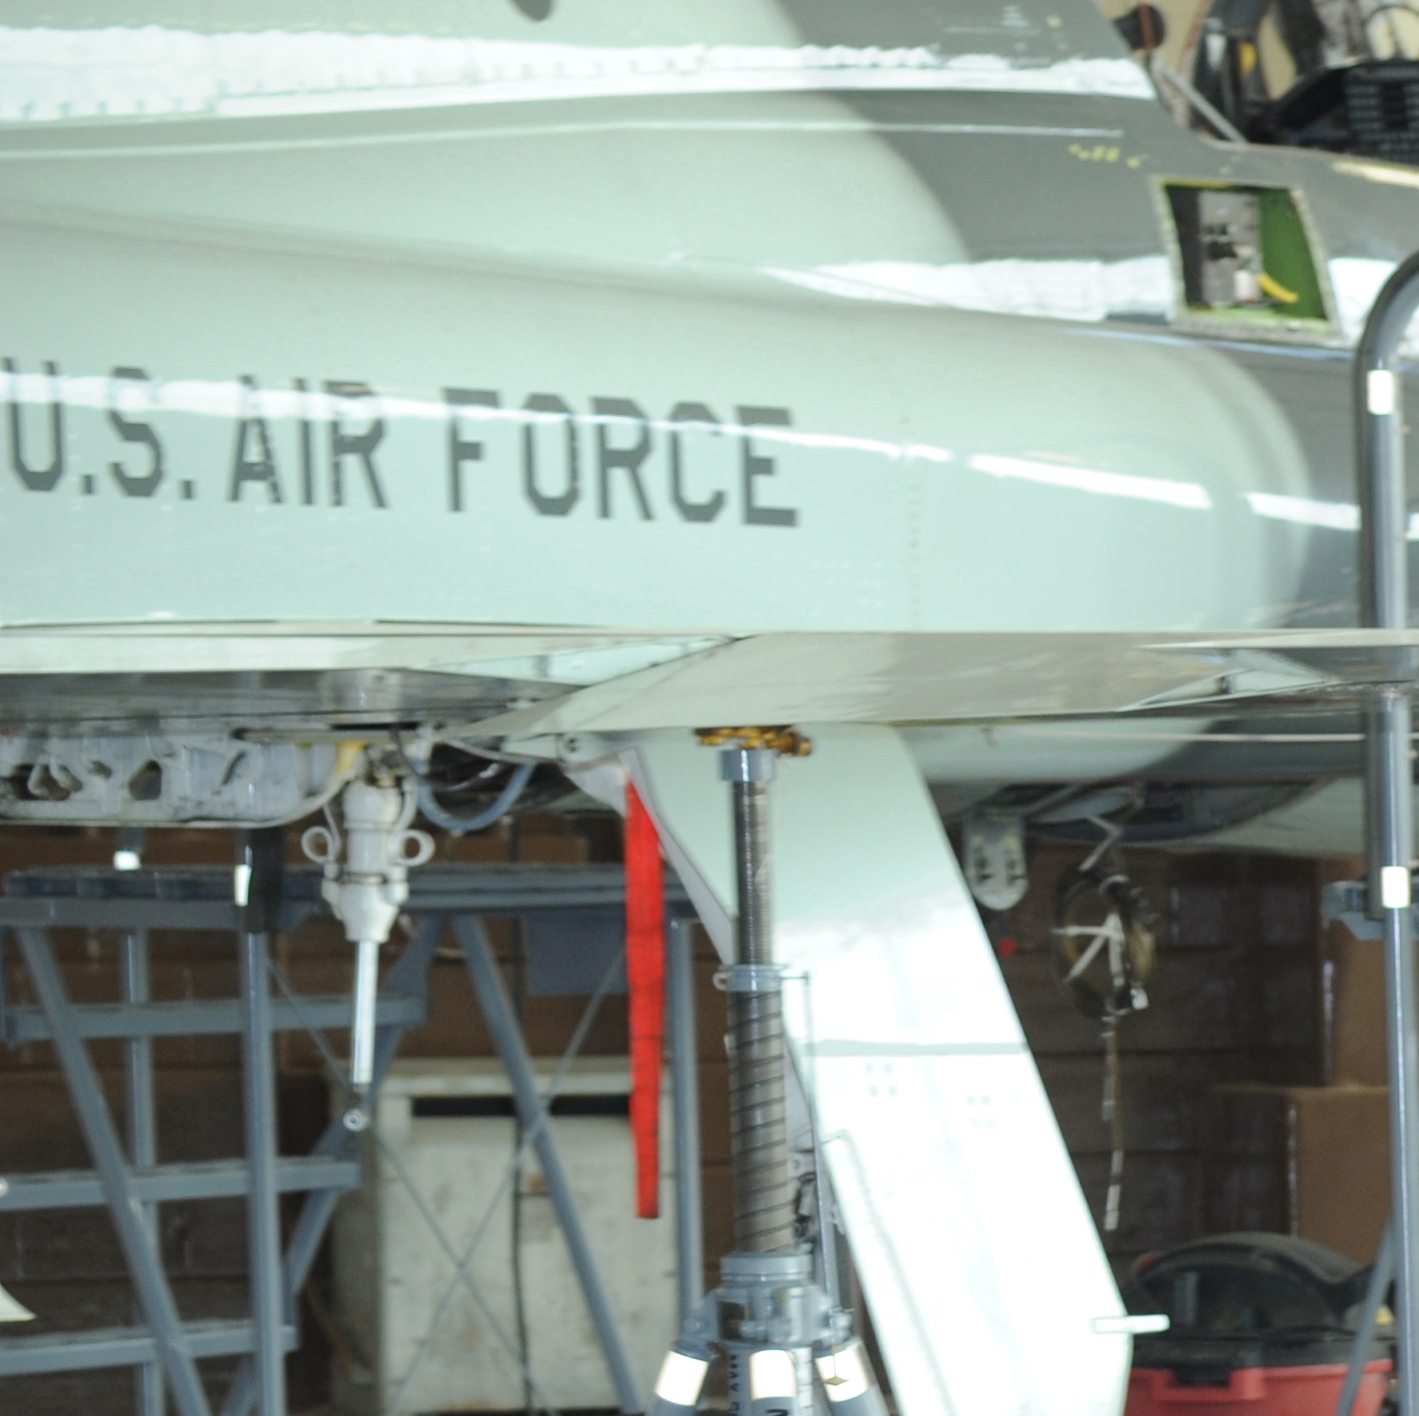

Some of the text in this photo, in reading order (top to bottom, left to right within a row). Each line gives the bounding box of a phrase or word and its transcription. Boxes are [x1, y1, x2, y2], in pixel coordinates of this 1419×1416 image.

[1, 356, 800, 529] U.S. AIR FORCE
